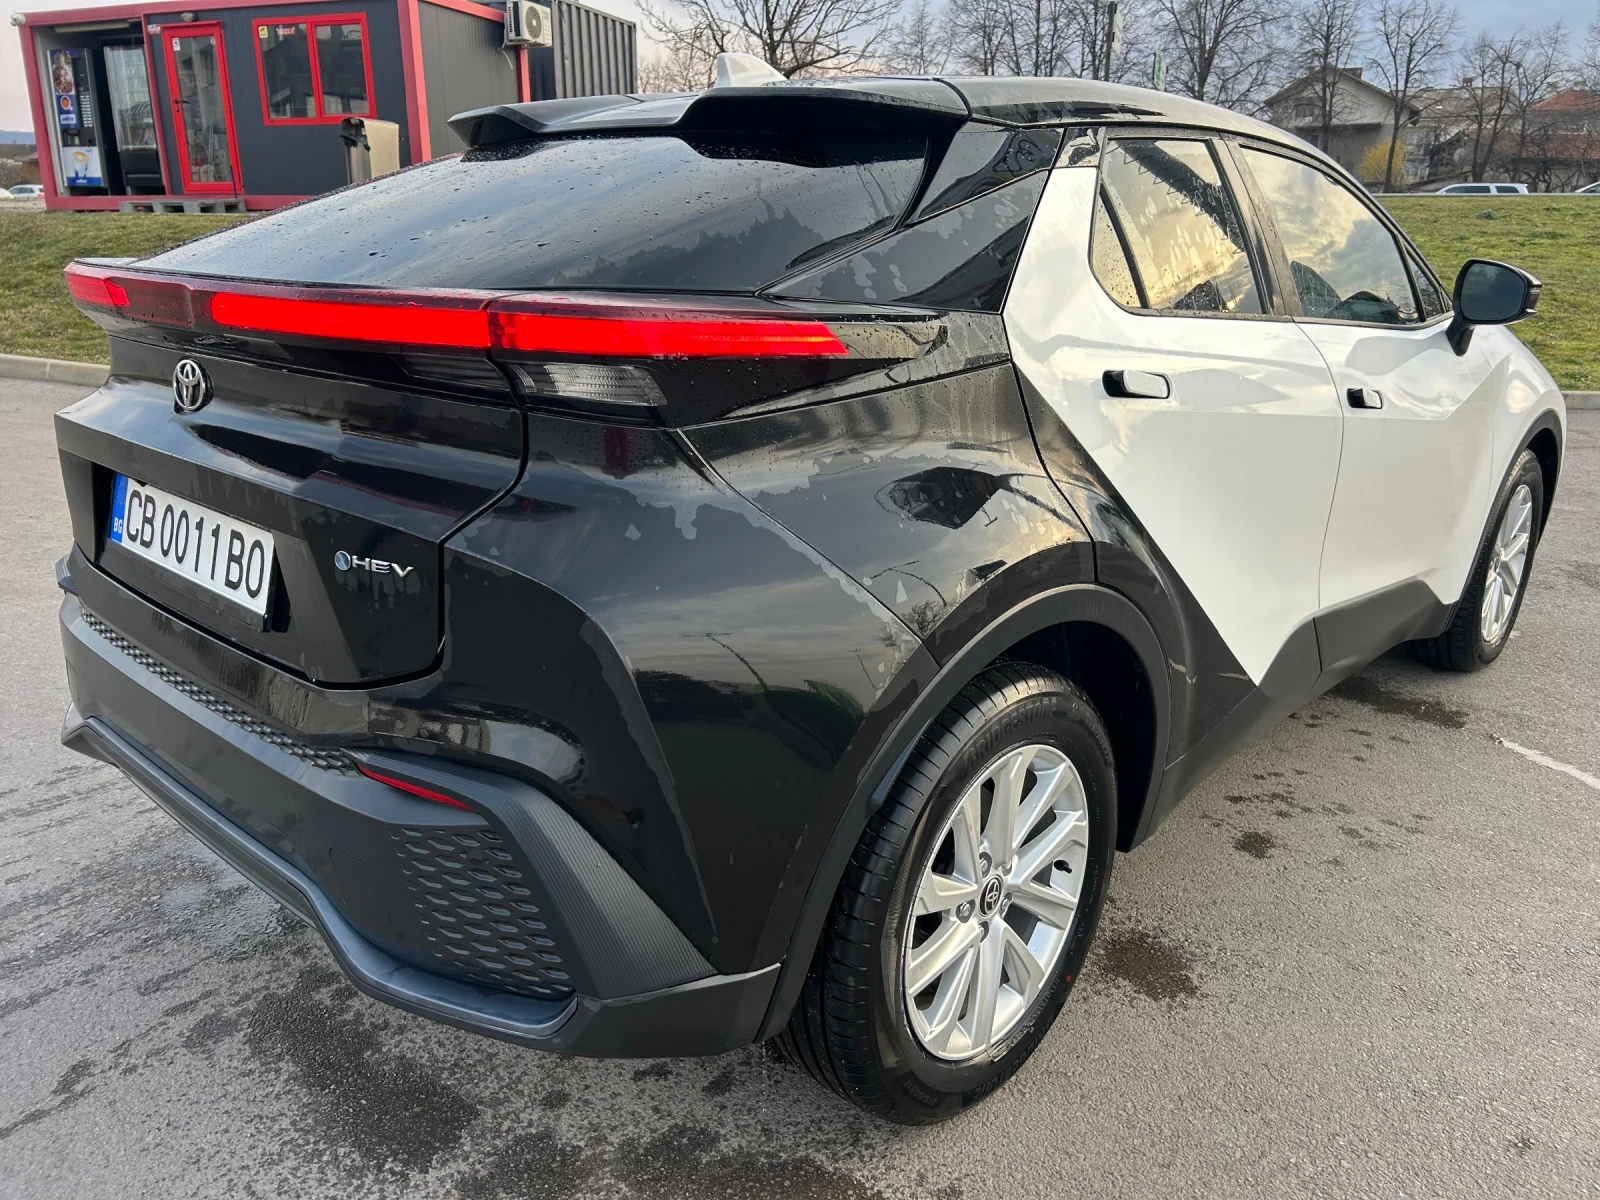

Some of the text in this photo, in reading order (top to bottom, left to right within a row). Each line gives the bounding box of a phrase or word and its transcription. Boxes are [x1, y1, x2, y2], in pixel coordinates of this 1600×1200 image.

[113, 517, 123, 534] BG
[352, 555, 414, 577] HEV
[963, 696, 1058, 769] BRIDGESTONE
